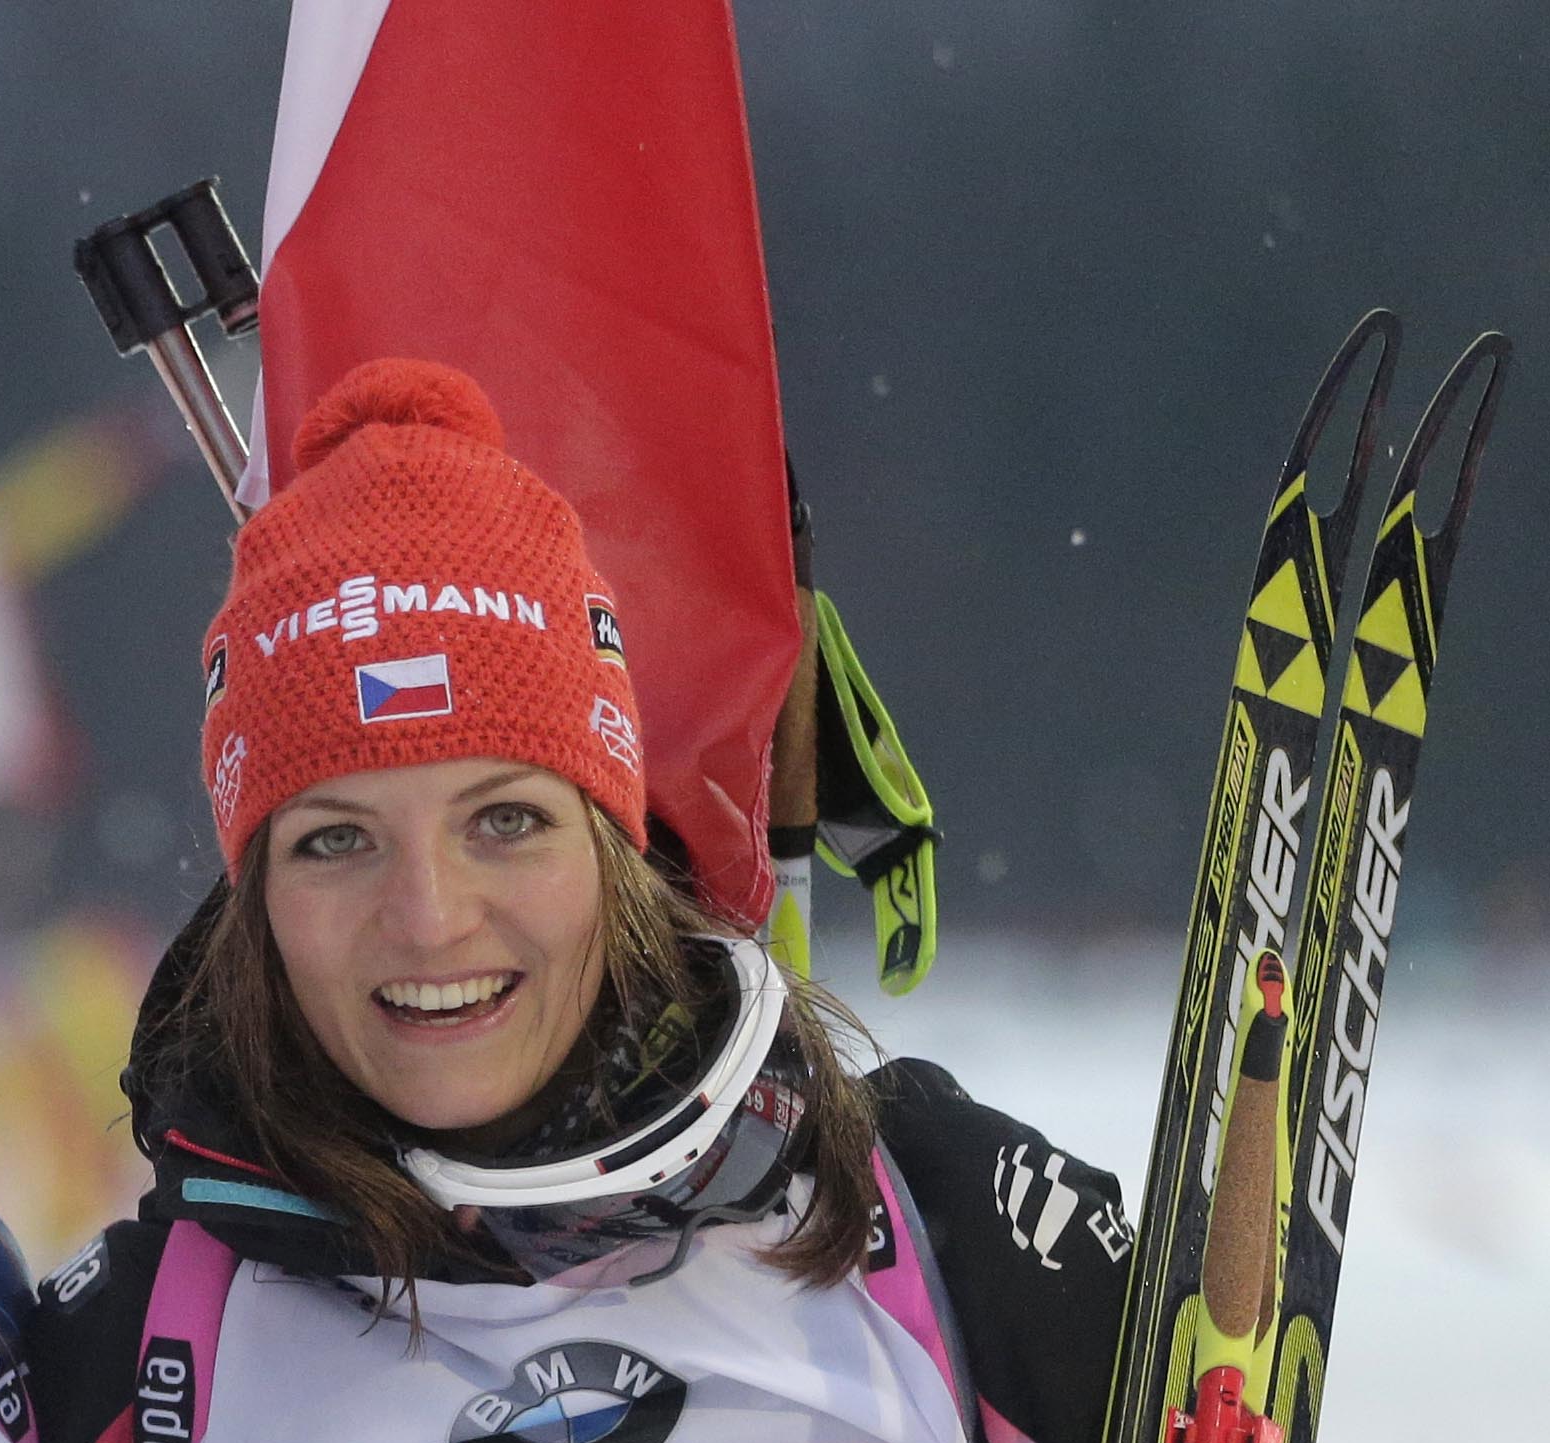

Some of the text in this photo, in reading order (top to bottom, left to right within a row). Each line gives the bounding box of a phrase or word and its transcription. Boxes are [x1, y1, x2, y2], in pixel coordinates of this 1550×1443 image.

[255, 575, 546, 657] VIESSMANN
[1308, 766, 1412, 1256] FISCHER
[471, 1350, 664, 1436] BMW
